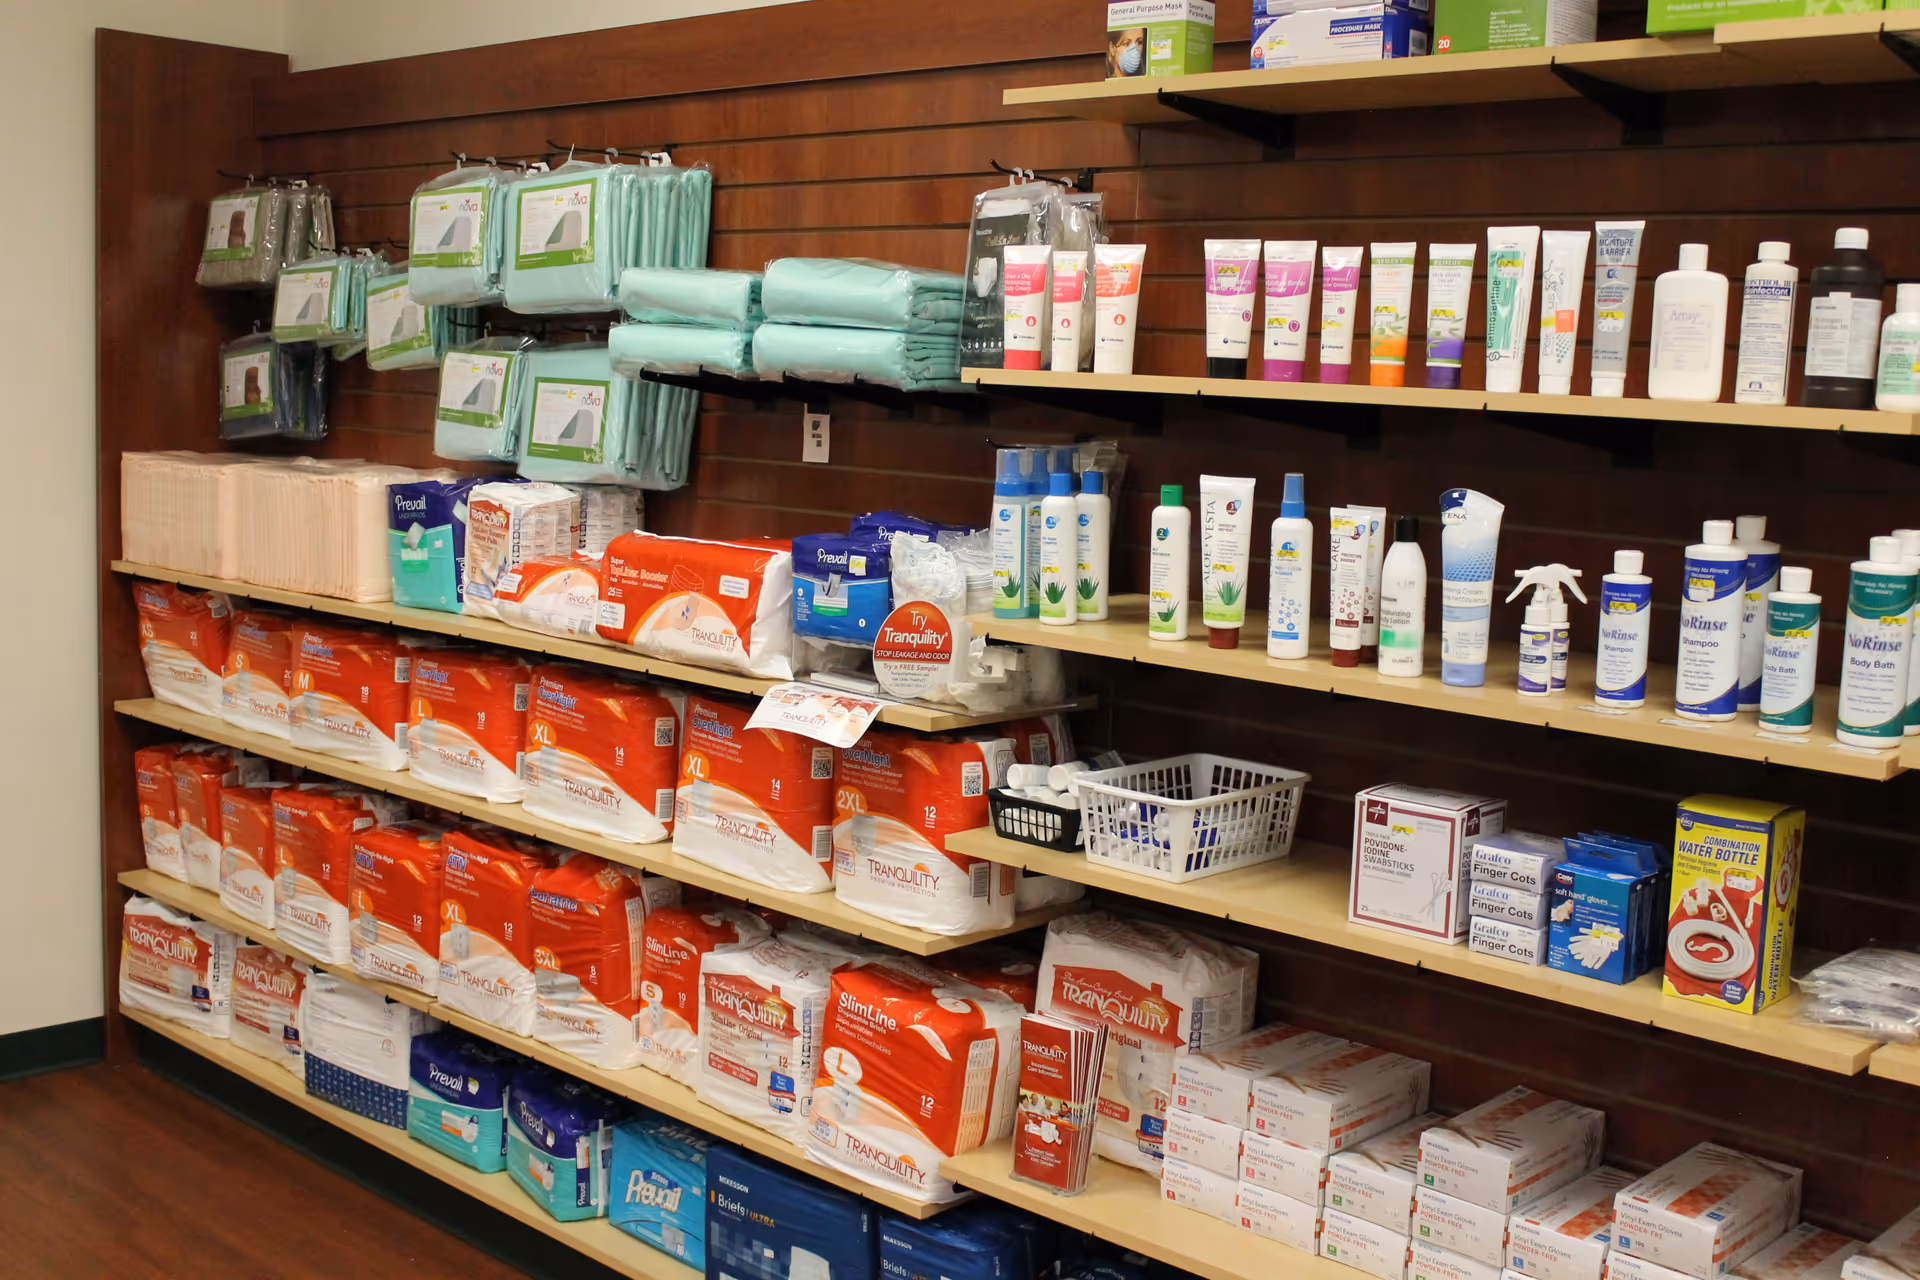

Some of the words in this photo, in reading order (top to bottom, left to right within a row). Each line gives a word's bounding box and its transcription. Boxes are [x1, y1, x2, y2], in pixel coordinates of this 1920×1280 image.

[1111, 6, 1135, 15] General
[1136, 4, 1163, 13] Purpose
[1330, 24, 1363, 34] PROCEDURE
[1438, 38, 1450, 49] 20
[459, 202, 478, 212] nova
[568, 195, 587, 206] nova
[1599, 238, 1634, 247] MOISTURE
[1600, 248, 1631, 256] BARRIER
[1669, 310, 1698, 322] Array
[486, 366, 503, 376] nova
[582, 395, 600, 406] nova
[395, 495, 426, 510] Prevail
[1205, 500, 1216, 540] VESTA
[817, 548, 848, 564] Prevail
[1332, 537, 1341, 572] CARE
[608, 587, 615, 596] 25
[1864, 587, 1893, 595] Necessary
[1888, 582, 1907, 590] Rinsing
[911, 611, 928, 630] Try
[141, 623, 153, 638] XS
[692, 627, 737, 647] TRANQUILITY
[1601, 628, 1638, 641] NoRinse
[1604, 644, 1633, 653] Shampoo
[1682, 637, 1719, 648] Shampoo
[1849, 634, 1903, 652] NoRinse
[236, 654, 243, 668] S
[1850, 657, 1870, 668] Body
[1874, 660, 1895, 669] Bath
[1779, 666, 1796, 674] Bath
[298, 673, 308, 689] M
[540, 676, 563, 692] Premium
[360, 686, 369, 696] 18
[538, 686, 577, 709] OverNight
[418, 700, 425, 717] L
[477, 712, 485, 722] 16
[694, 704, 718, 719] Premium
[692, 714, 734, 738] OverNight
[780, 711, 829, 727] TRANQUILITY
[324, 718, 370, 739] TRANQUILITY
[534, 723, 552, 745] XL
[438, 749, 485, 770] TRANQUILITY
[615, 747, 624, 757] 14
[842, 748, 891, 768] OverNight
[687, 754, 704, 778] XL
[771, 778, 780, 790] 14
[563, 778, 621, 810] TRANQUILITY
[837, 790, 865, 813] 2XL
[924, 806, 936, 818] 12
[715, 814, 776, 846] TRANQUILITY
[1364, 846, 1390, 858] IODINE
[1365, 838, 1408, 852] POVIDONE-
[1679, 840, 1712, 858] WATER
[1715, 848, 1759, 866] BOTTLE
[1704, 836, 1760, 853] COMBINATION
[280, 848, 286, 863] L
[447, 854, 467, 871] ATN
[1364, 855, 1415, 872] SWABSTICKS
[322, 864, 330, 872] 12
[867, 858, 939, 890] TRANQUILITY
[1473, 864, 1506, 879] Finger
[1511, 872, 1536, 885] Cots
[870, 876, 896, 887] PREMIUM
[897, 882, 936, 898] PROTECTION
[358, 892, 364, 909] L
[1555, 888, 1567, 896] soft
[1569, 890, 1585, 900] hand
[1587, 896, 1608, 905] gloves
[445, 903, 462, 923] XL
[1472, 899, 1505, 914] Finger
[1508, 908, 1533, 920] Cots
[290, 906, 332, 932] TRANQUILITY
[413, 915, 422, 924] 12
[504, 922, 513, 933] 12
[130, 927, 197, 963] TRANQUILITY
[646, 936, 688, 959] SlimLine
[1472, 936, 1506, 951] Finger
[1509, 945, 1534, 958] Cots
[535, 949, 559, 970] 3XL
[370, 953, 424, 984] TRANQUILITY
[590, 966, 596, 975] 8
[236, 960, 296, 997] TRANQUILITY
[461, 971, 516, 998] TRANQUILITY
[646, 984, 656, 998] S
[678, 992, 686, 1002] 10
[710, 986, 786, 1030] TRANQUILITY
[839, 992, 897, 1030] SlimLine
[1063, 981, 1169, 1034] TRANQUILITY
[711, 1012, 737, 1030] SlimLine
[739, 1023, 762, 1041] Original
[838, 1007, 868, 1027] Disposable
[869, 1021, 887, 1034] Briefs
[1023, 1040, 1067, 1059] TRANQUILITY
[779, 1056, 788, 1068] 12
[837, 1052, 847, 1076] L
[1031, 1061, 1058, 1073] Incontinence
[429, 1063, 463, 1092] Prevail
[1039, 1068, 1063, 1080] Information
[920, 1095, 934, 1109] 12
[1154, 1097, 1166, 1112] 12
[520, 1102, 544, 1135] Prevail
[845, 1133, 926, 1183] TRANQUILITY
[1425, 1152, 1439, 1161] Vinyl
[1441, 1156, 1456, 1167] Exam
[1457, 1162, 1478, 1174] Gloves
[1425, 1159, 1466, 1177] POWDER-FREE
[625, 1170, 682, 1213] Prevail
[1333, 1180, 1373, 1199] POWDER-FREE
[1334, 1172, 1348, 1182] Vinyl
[1349, 1177, 1364, 1187] Exam
[1365, 1183, 1385, 1195] Gloves
[577, 1182, 586, 1206] Prevail
[718, 1193, 746, 1217] Briefs
[750, 1211, 775, 1229] ULTRA
[1422, 1202, 1436, 1213] Vinyl
[1437, 1208, 1453, 1218] Exam
[1454, 1214, 1476, 1226] Gloves
[1421, 1211, 1463, 1230] POWDER-FREE
[1621, 1212, 1637, 1222] Vinyl
[1638, 1218, 1657, 1228] Exam
[1658, 1224, 1682, 1238] Gloves
[676, 1244, 684, 1256] 16
[1514, 1234, 1529, 1244] Vinyl
[1530, 1239, 1547, 1250] Exam
[1548, 1245, 1572, 1259] Gloves
[1514, 1242, 1557, 1262] POWDER-FREE
[883, 1259, 906, 1277] Briefs
